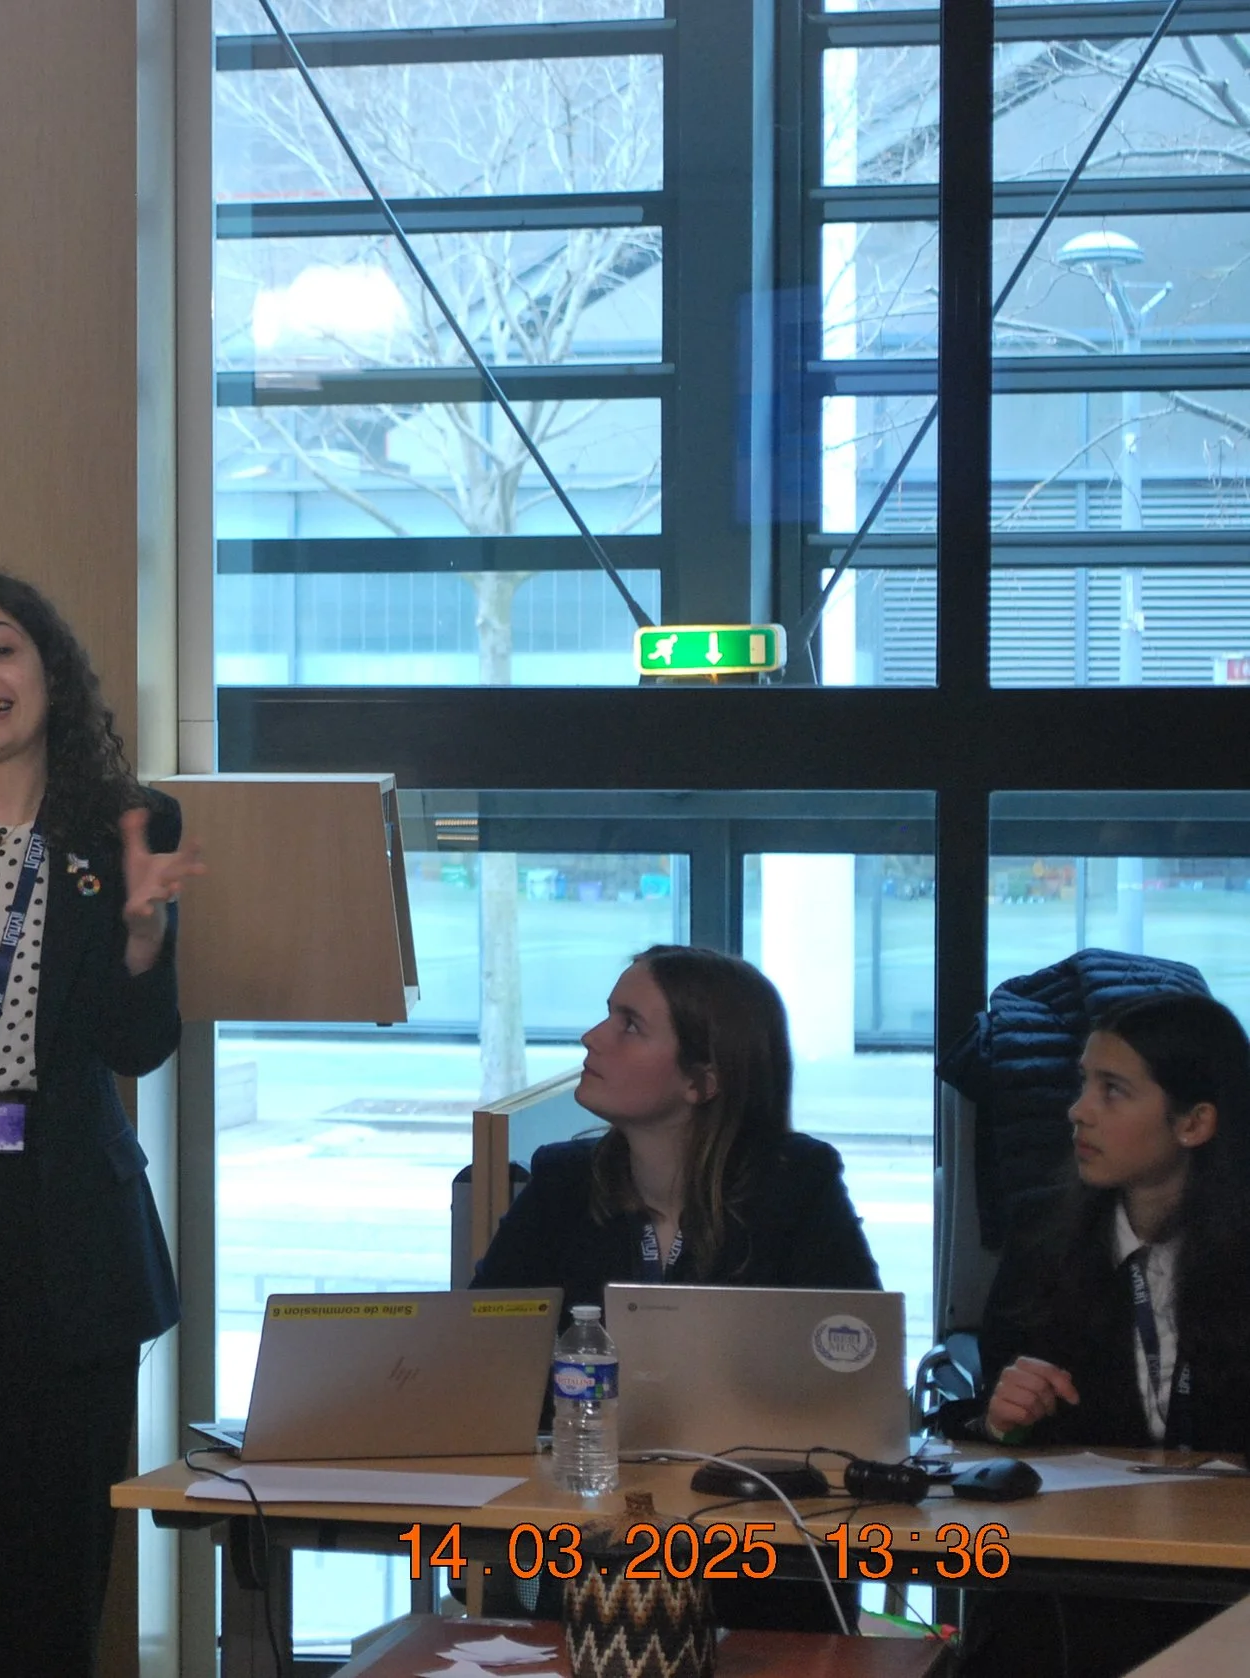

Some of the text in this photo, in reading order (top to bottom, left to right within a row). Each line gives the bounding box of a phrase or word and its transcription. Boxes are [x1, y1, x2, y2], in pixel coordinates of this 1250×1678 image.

[284, 1307, 360, 1317] commission
[363, 1306, 379, 1316] de
[382, 1305, 413, 1316] Salle
